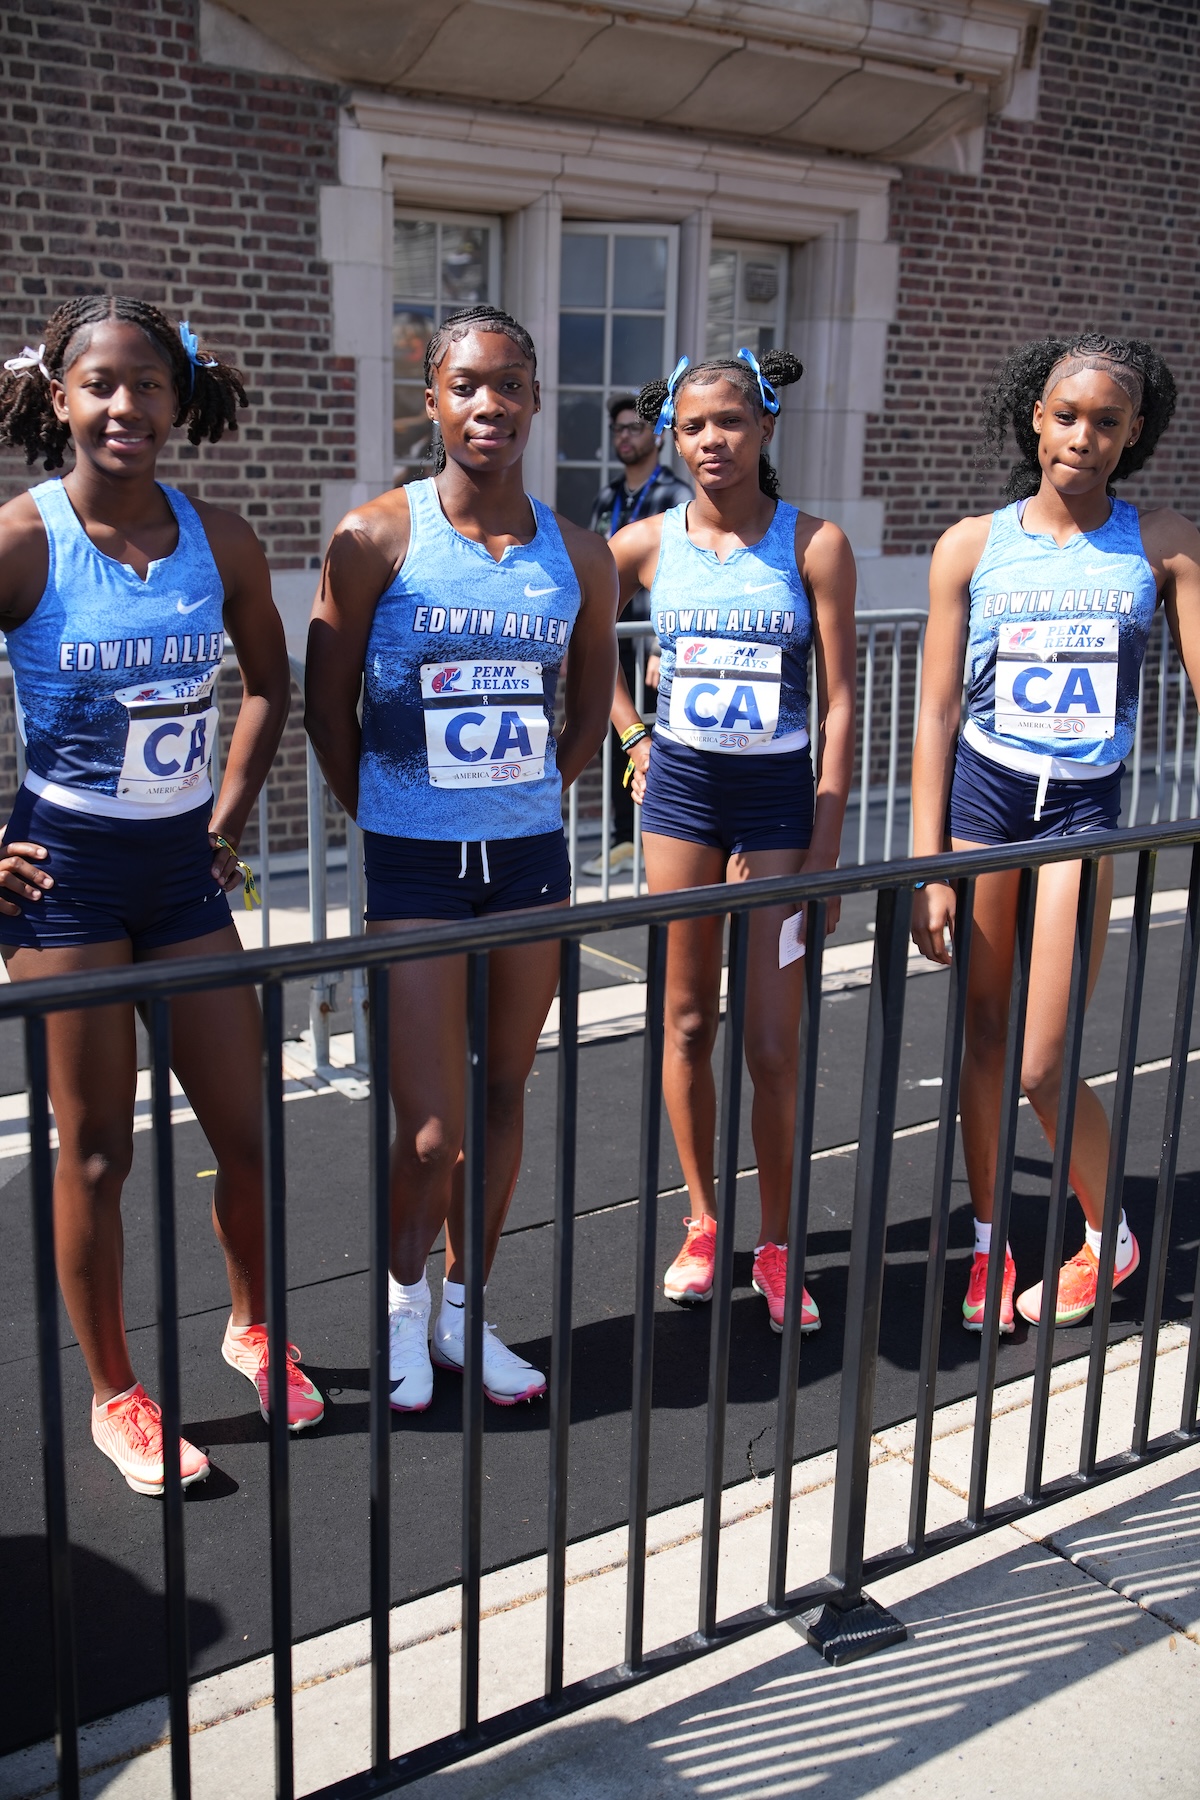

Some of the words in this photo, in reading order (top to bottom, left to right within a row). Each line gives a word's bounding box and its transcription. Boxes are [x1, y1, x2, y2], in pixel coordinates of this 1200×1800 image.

[983, 590, 1054, 618] EDWIN
[1059, 589, 1134, 614] ALLEN
[412, 606, 495, 635] EDWIN
[502, 612, 569, 646] ALLEN
[657, 609, 719, 634] EDWIN
[725, 609, 795, 634] ALLEN
[1047, 625, 1092, 636] PENN
[1044, 637, 1105, 648] RELAYS
[59, 637, 152, 671] EDWIN
[713, 656, 768, 669] RELAYS
[472, 666, 517, 677] PENN
[471, 678, 530, 690] RELAYS
[1012, 666, 1101, 714] CA
[684, 683, 764, 730] CA
[1017, 721, 1051, 730] AMERICA
[445, 711, 533, 763] CA
[143, 717, 207, 777] CA
[453, 771, 490, 780] AMERICA
[146, 785, 182, 795] AMERICA
